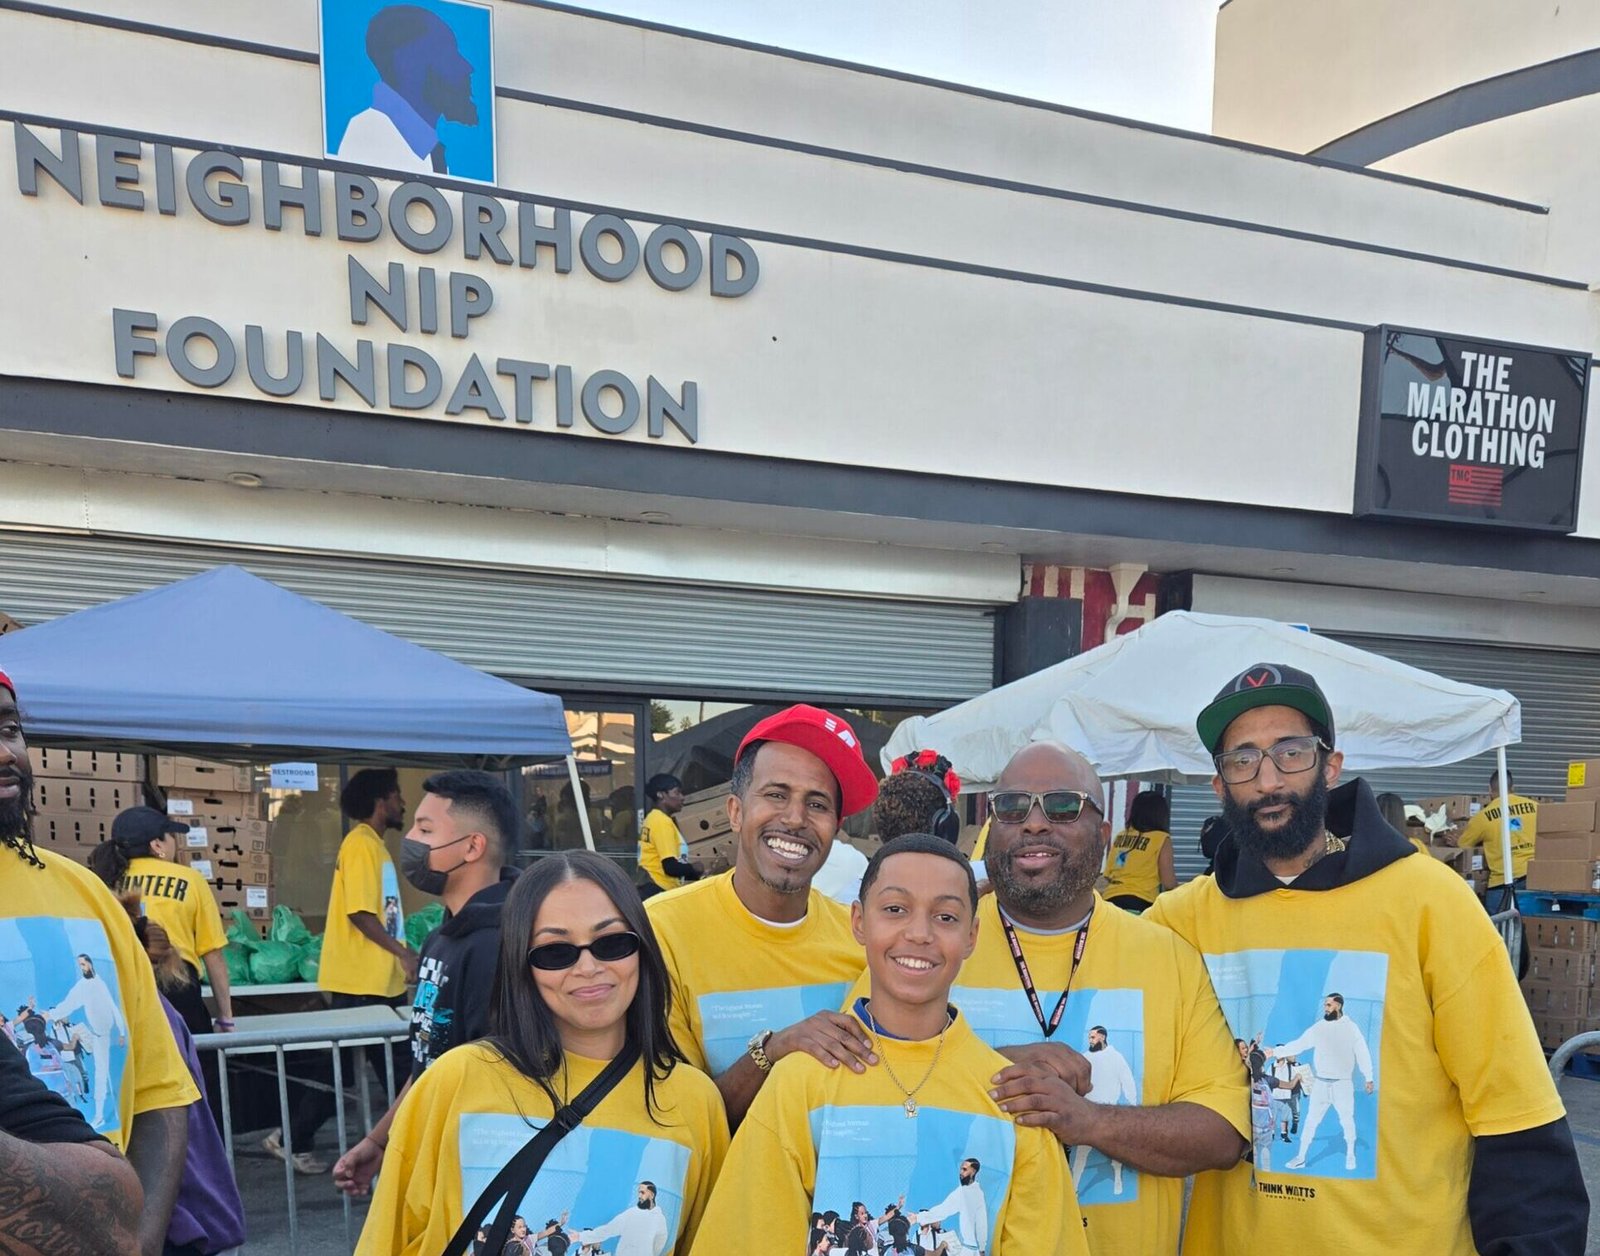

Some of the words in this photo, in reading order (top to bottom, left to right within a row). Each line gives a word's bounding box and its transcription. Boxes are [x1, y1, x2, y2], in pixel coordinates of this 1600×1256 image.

[13, 120, 760, 298] NEIGHBORHOOD
[348, 254, 495, 339] NIP
[112, 307, 698, 445] FOUNDATION
[1461, 351, 1513, 391] THE
[1406, 381, 1556, 433] MARATHON
[1412, 420, 1546, 469] CLOTHING
[1451, 469, 1471, 482] TMC
[272, 768, 315, 777] RESTROOMS
[1484, 802, 1536, 821] VOLNTEER
[120, 874, 188, 902] NTEER
[1259, 1182, 1283, 1194] THINK
[1285, 1184, 1316, 1198] WATTS
